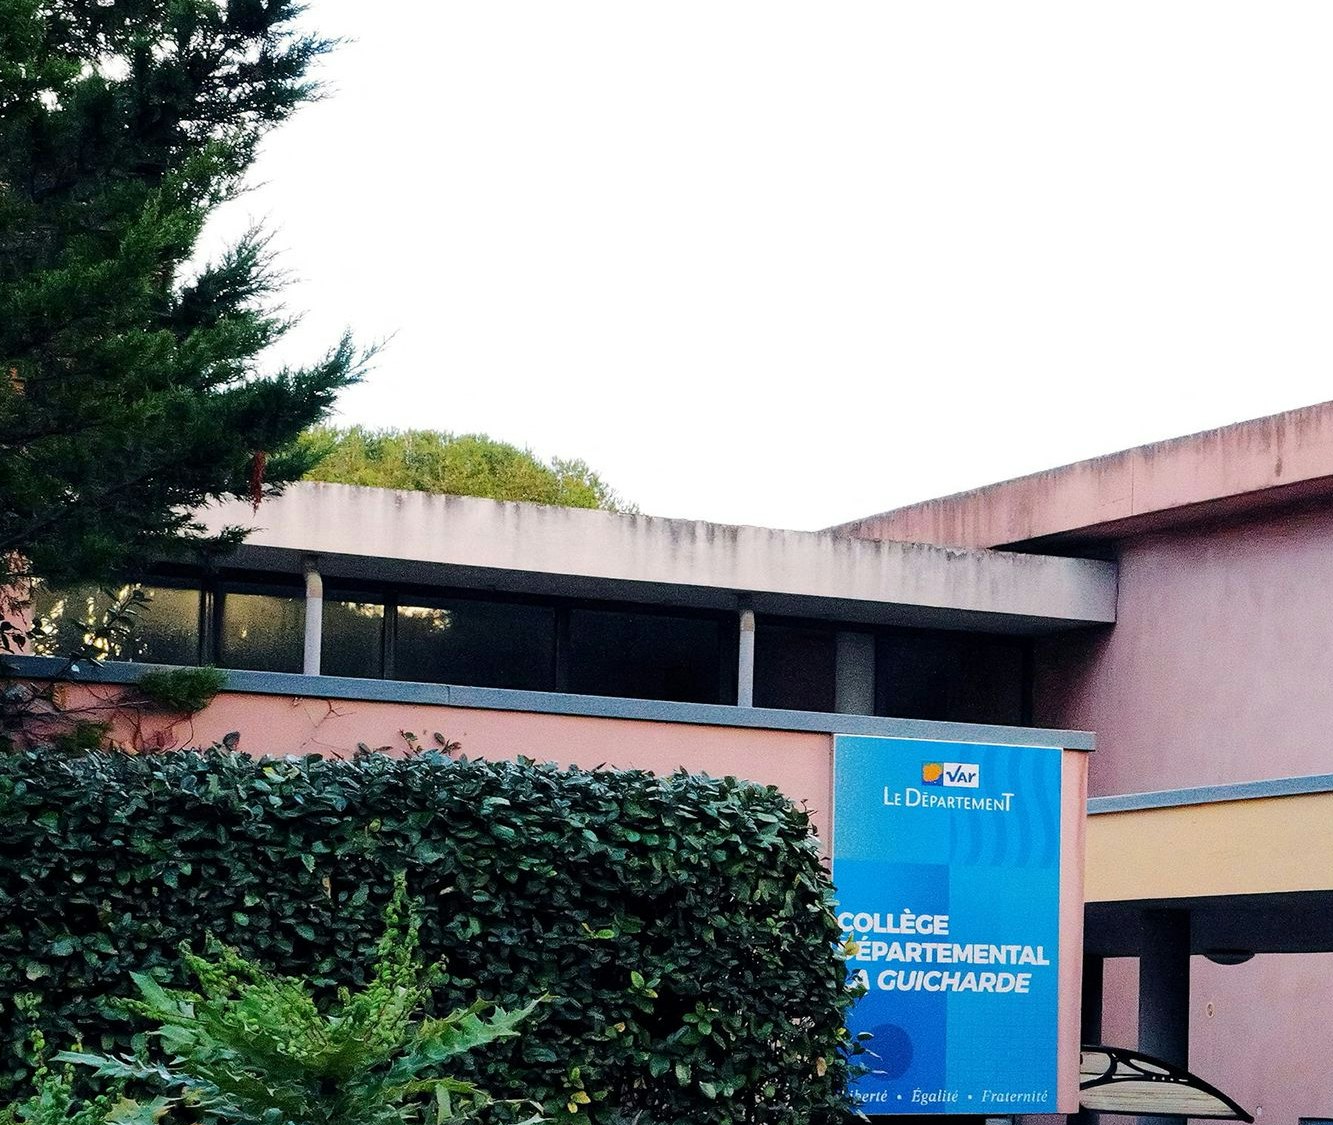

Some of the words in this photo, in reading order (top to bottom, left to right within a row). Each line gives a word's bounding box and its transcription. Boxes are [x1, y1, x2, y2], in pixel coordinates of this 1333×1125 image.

[837, 908, 950, 936] COLLÈGE
[877, 969, 1033, 994] GUICHARDE
[842, 1089, 888, 1103] iberté
[911, 1087, 960, 1106] Égalité
[982, 1089, 1049, 1103] Fraternité
